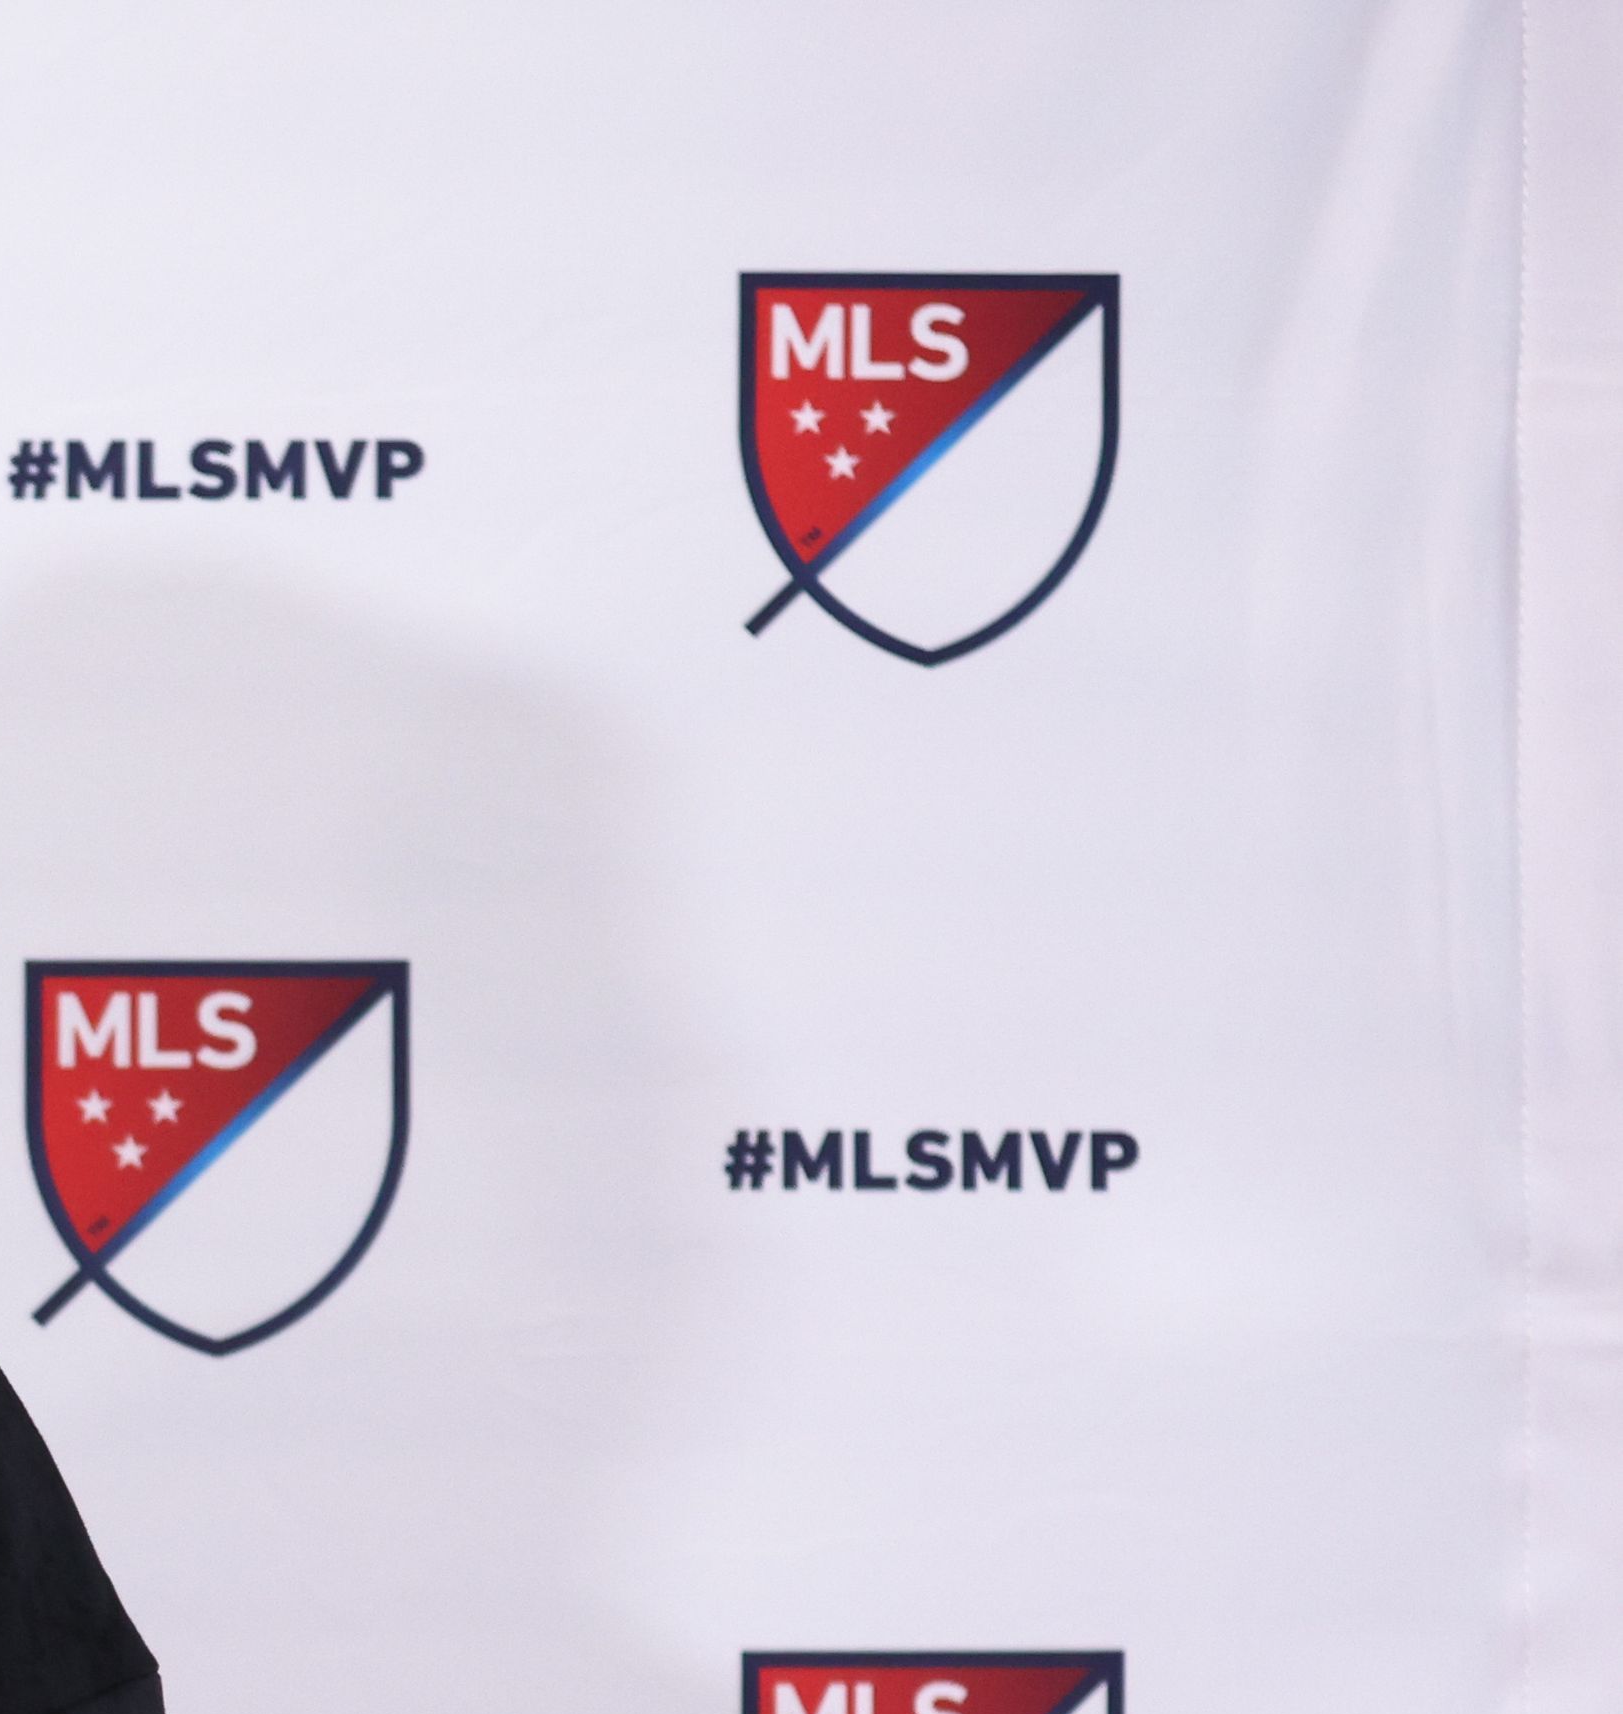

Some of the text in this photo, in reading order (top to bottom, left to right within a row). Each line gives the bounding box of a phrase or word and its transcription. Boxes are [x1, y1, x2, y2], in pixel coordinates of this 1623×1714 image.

[770, 303, 969, 382] MLS
[8, 438, 425, 501] #MLSMVP
[57, 990, 257, 1070] MLS
[723, 1128, 1140, 1192] #MLSMVP
